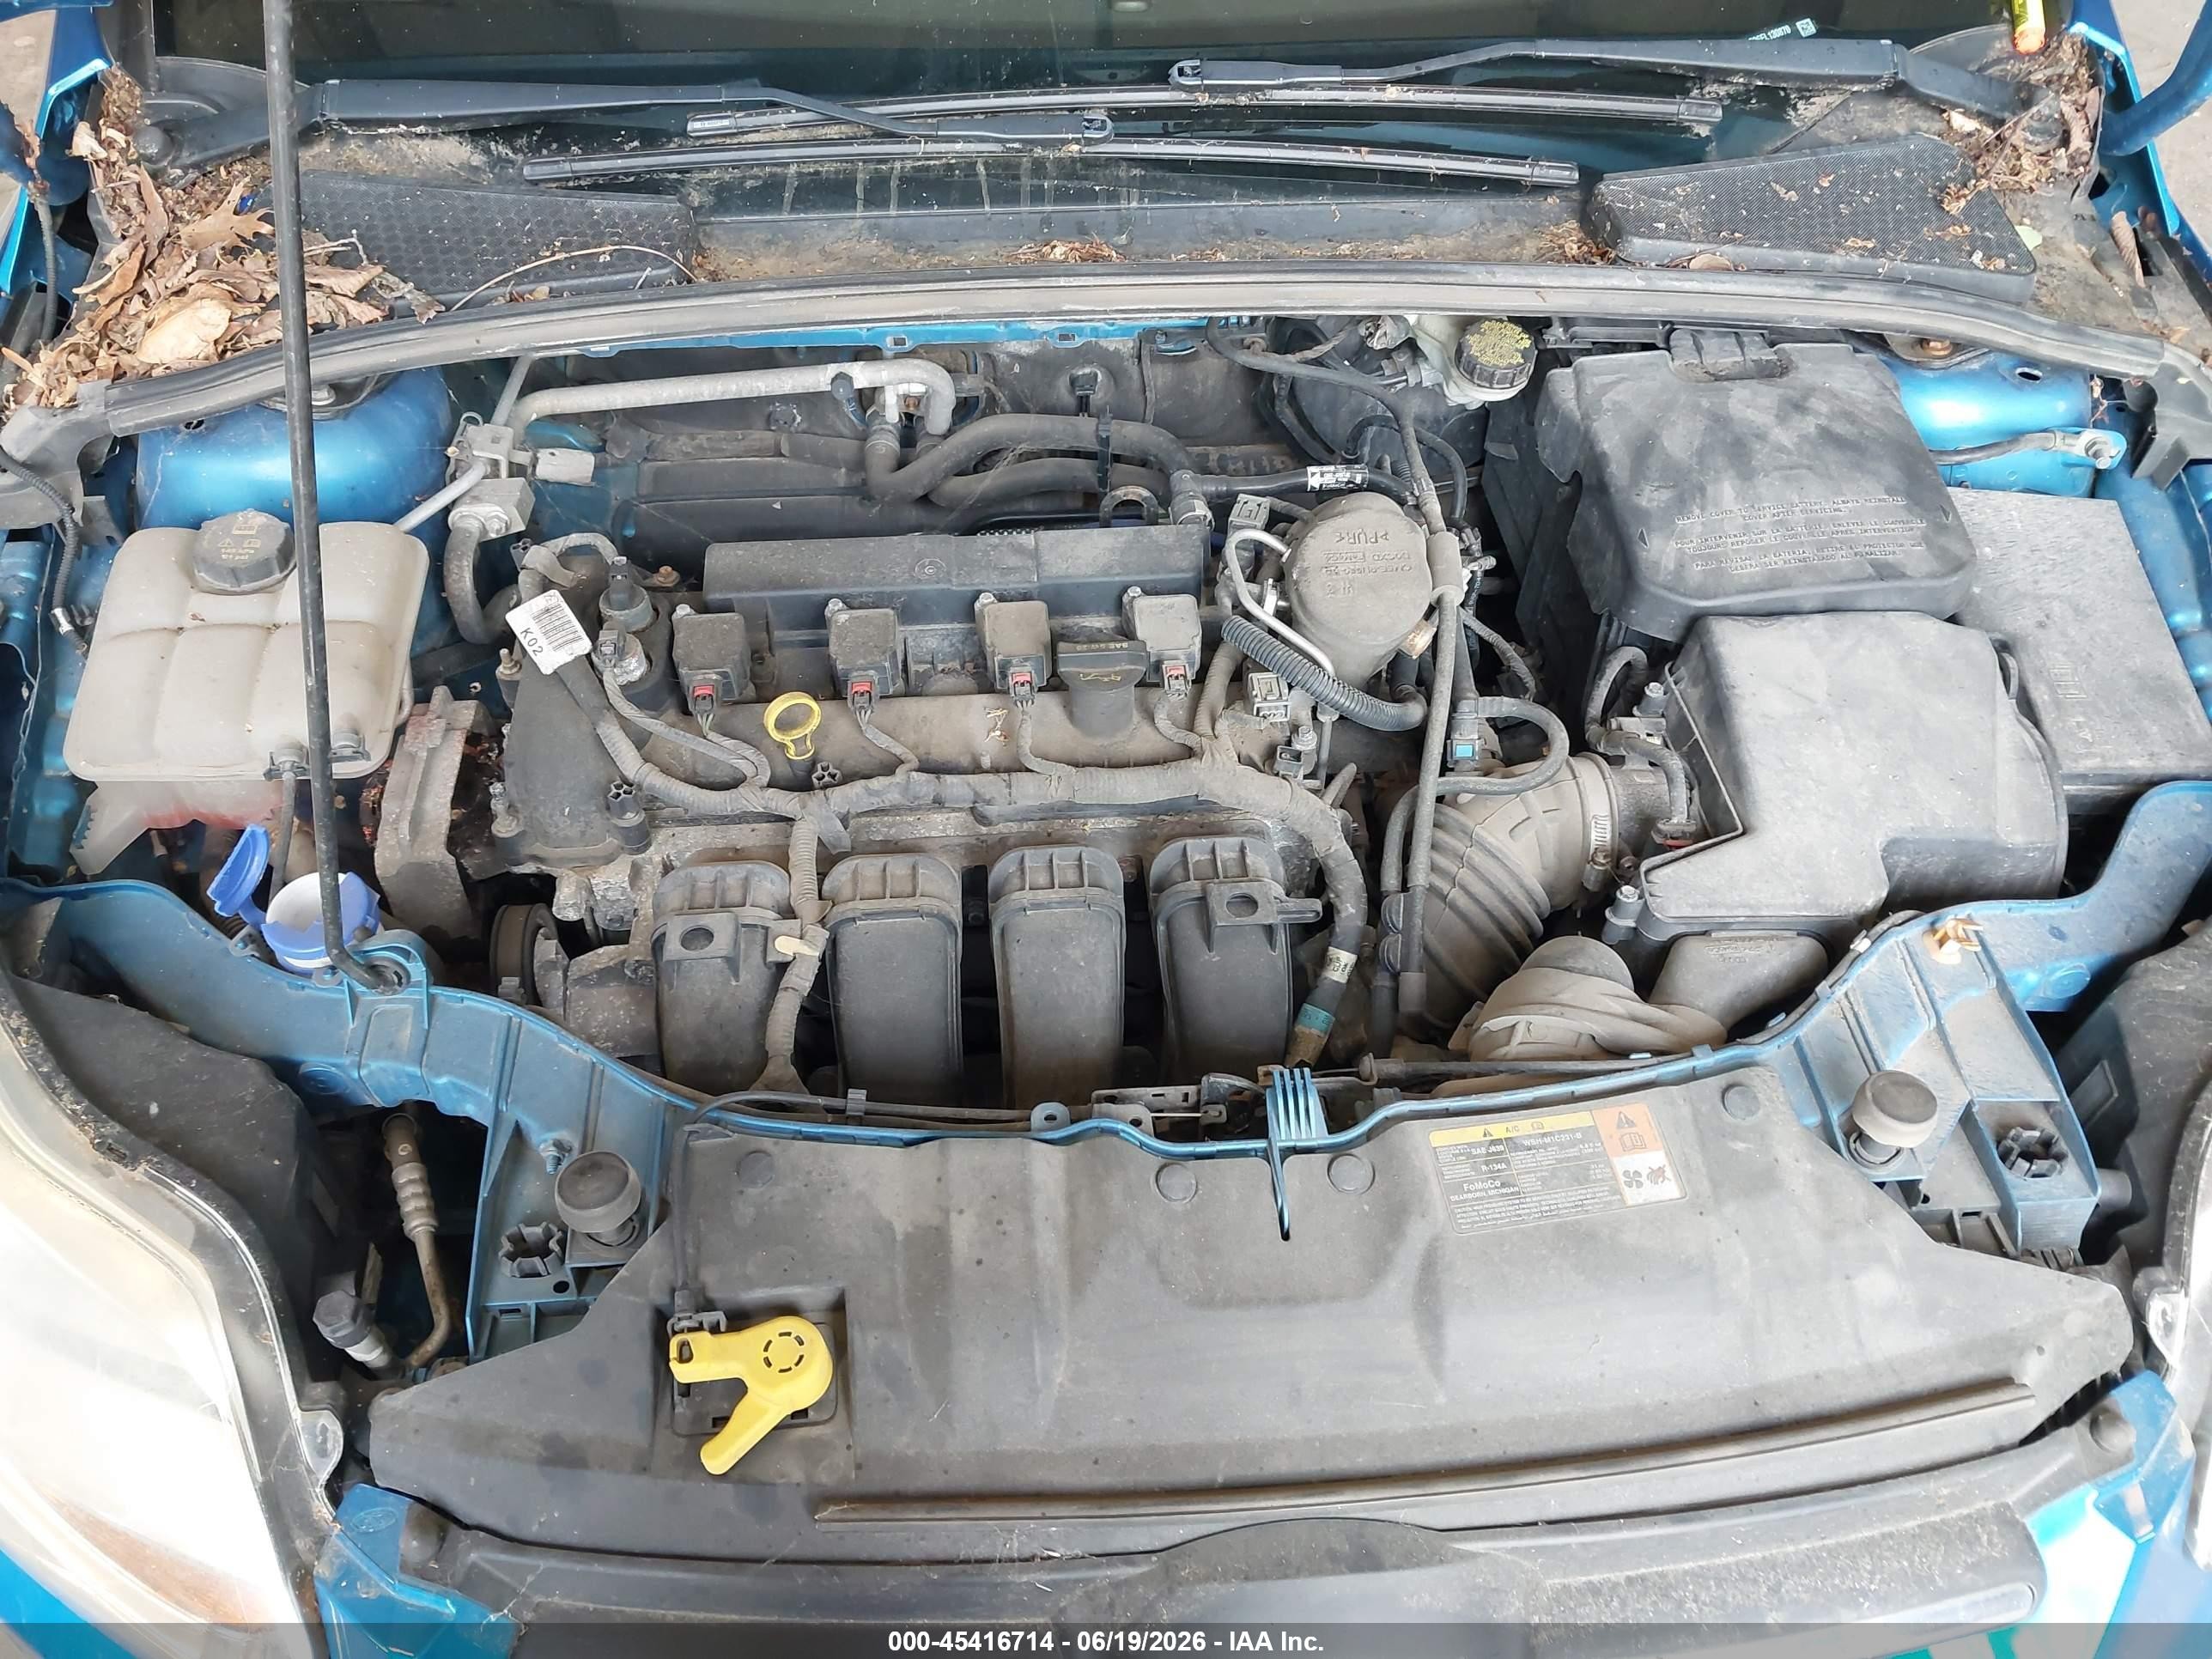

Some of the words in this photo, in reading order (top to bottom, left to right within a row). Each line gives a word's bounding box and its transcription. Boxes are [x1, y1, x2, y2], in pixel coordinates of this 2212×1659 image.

[1710, 510, 1733, 519] COVER
[520, 627, 544, 657] K02
[1471, 1146, 1487, 1155] SAE
[1480, 1162, 1508, 1173] R-134A
[1462, 1179, 1501, 1192] FoMoCo
